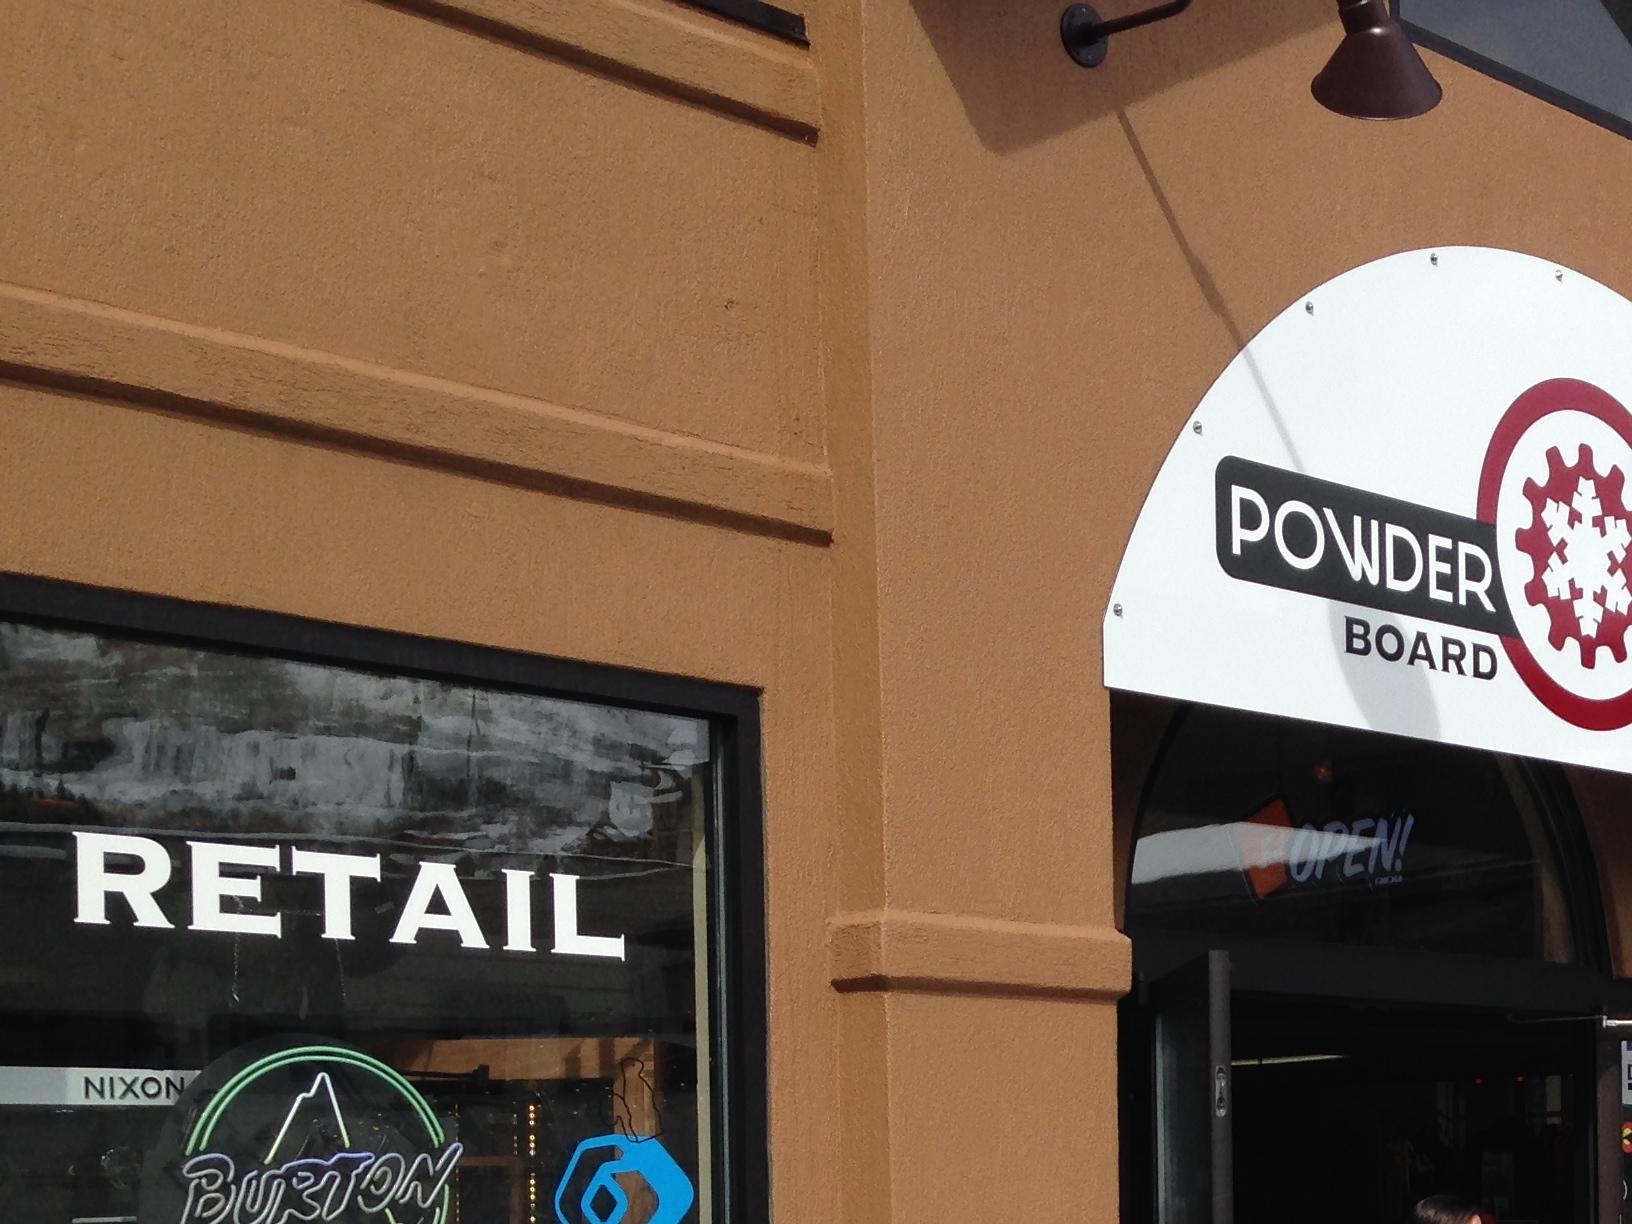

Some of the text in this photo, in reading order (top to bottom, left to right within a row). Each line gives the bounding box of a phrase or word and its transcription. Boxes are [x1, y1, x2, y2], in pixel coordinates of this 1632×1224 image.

[1230, 484, 1496, 613] POWDER
[1344, 616, 1498, 681] BOARD
[1289, 814, 1414, 882] OPEN!
[72, 831, 626, 962] RETAIL
[84, 1076, 184, 1099] NIXON
